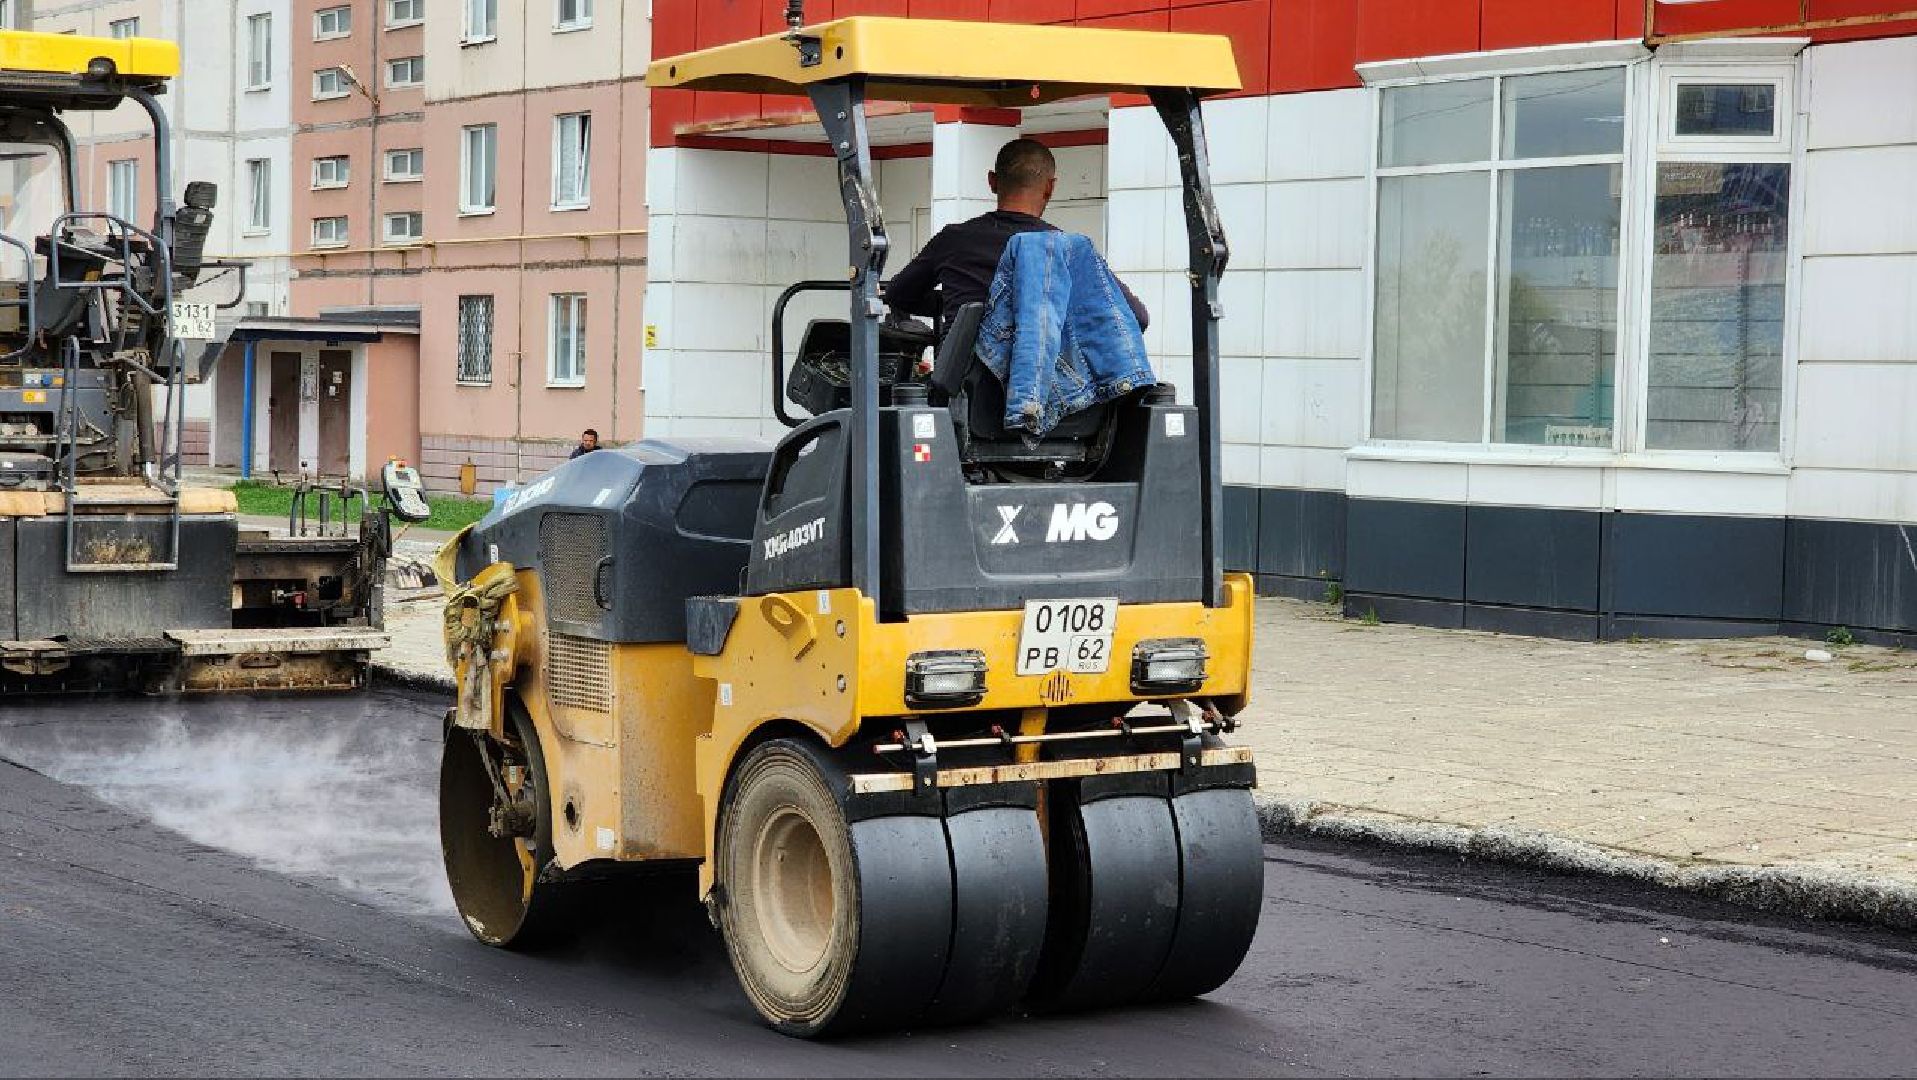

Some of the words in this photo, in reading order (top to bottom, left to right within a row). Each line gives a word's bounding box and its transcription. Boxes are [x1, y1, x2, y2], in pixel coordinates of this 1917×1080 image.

[174, 304, 209, 319] 3131
[991, 505, 1024, 544] X
[1045, 501, 1119, 542] MG
[1036, 604, 1105, 633] 0108
[1025, 647, 1059, 669] РВ
[1078, 638, 1104, 660] 62
